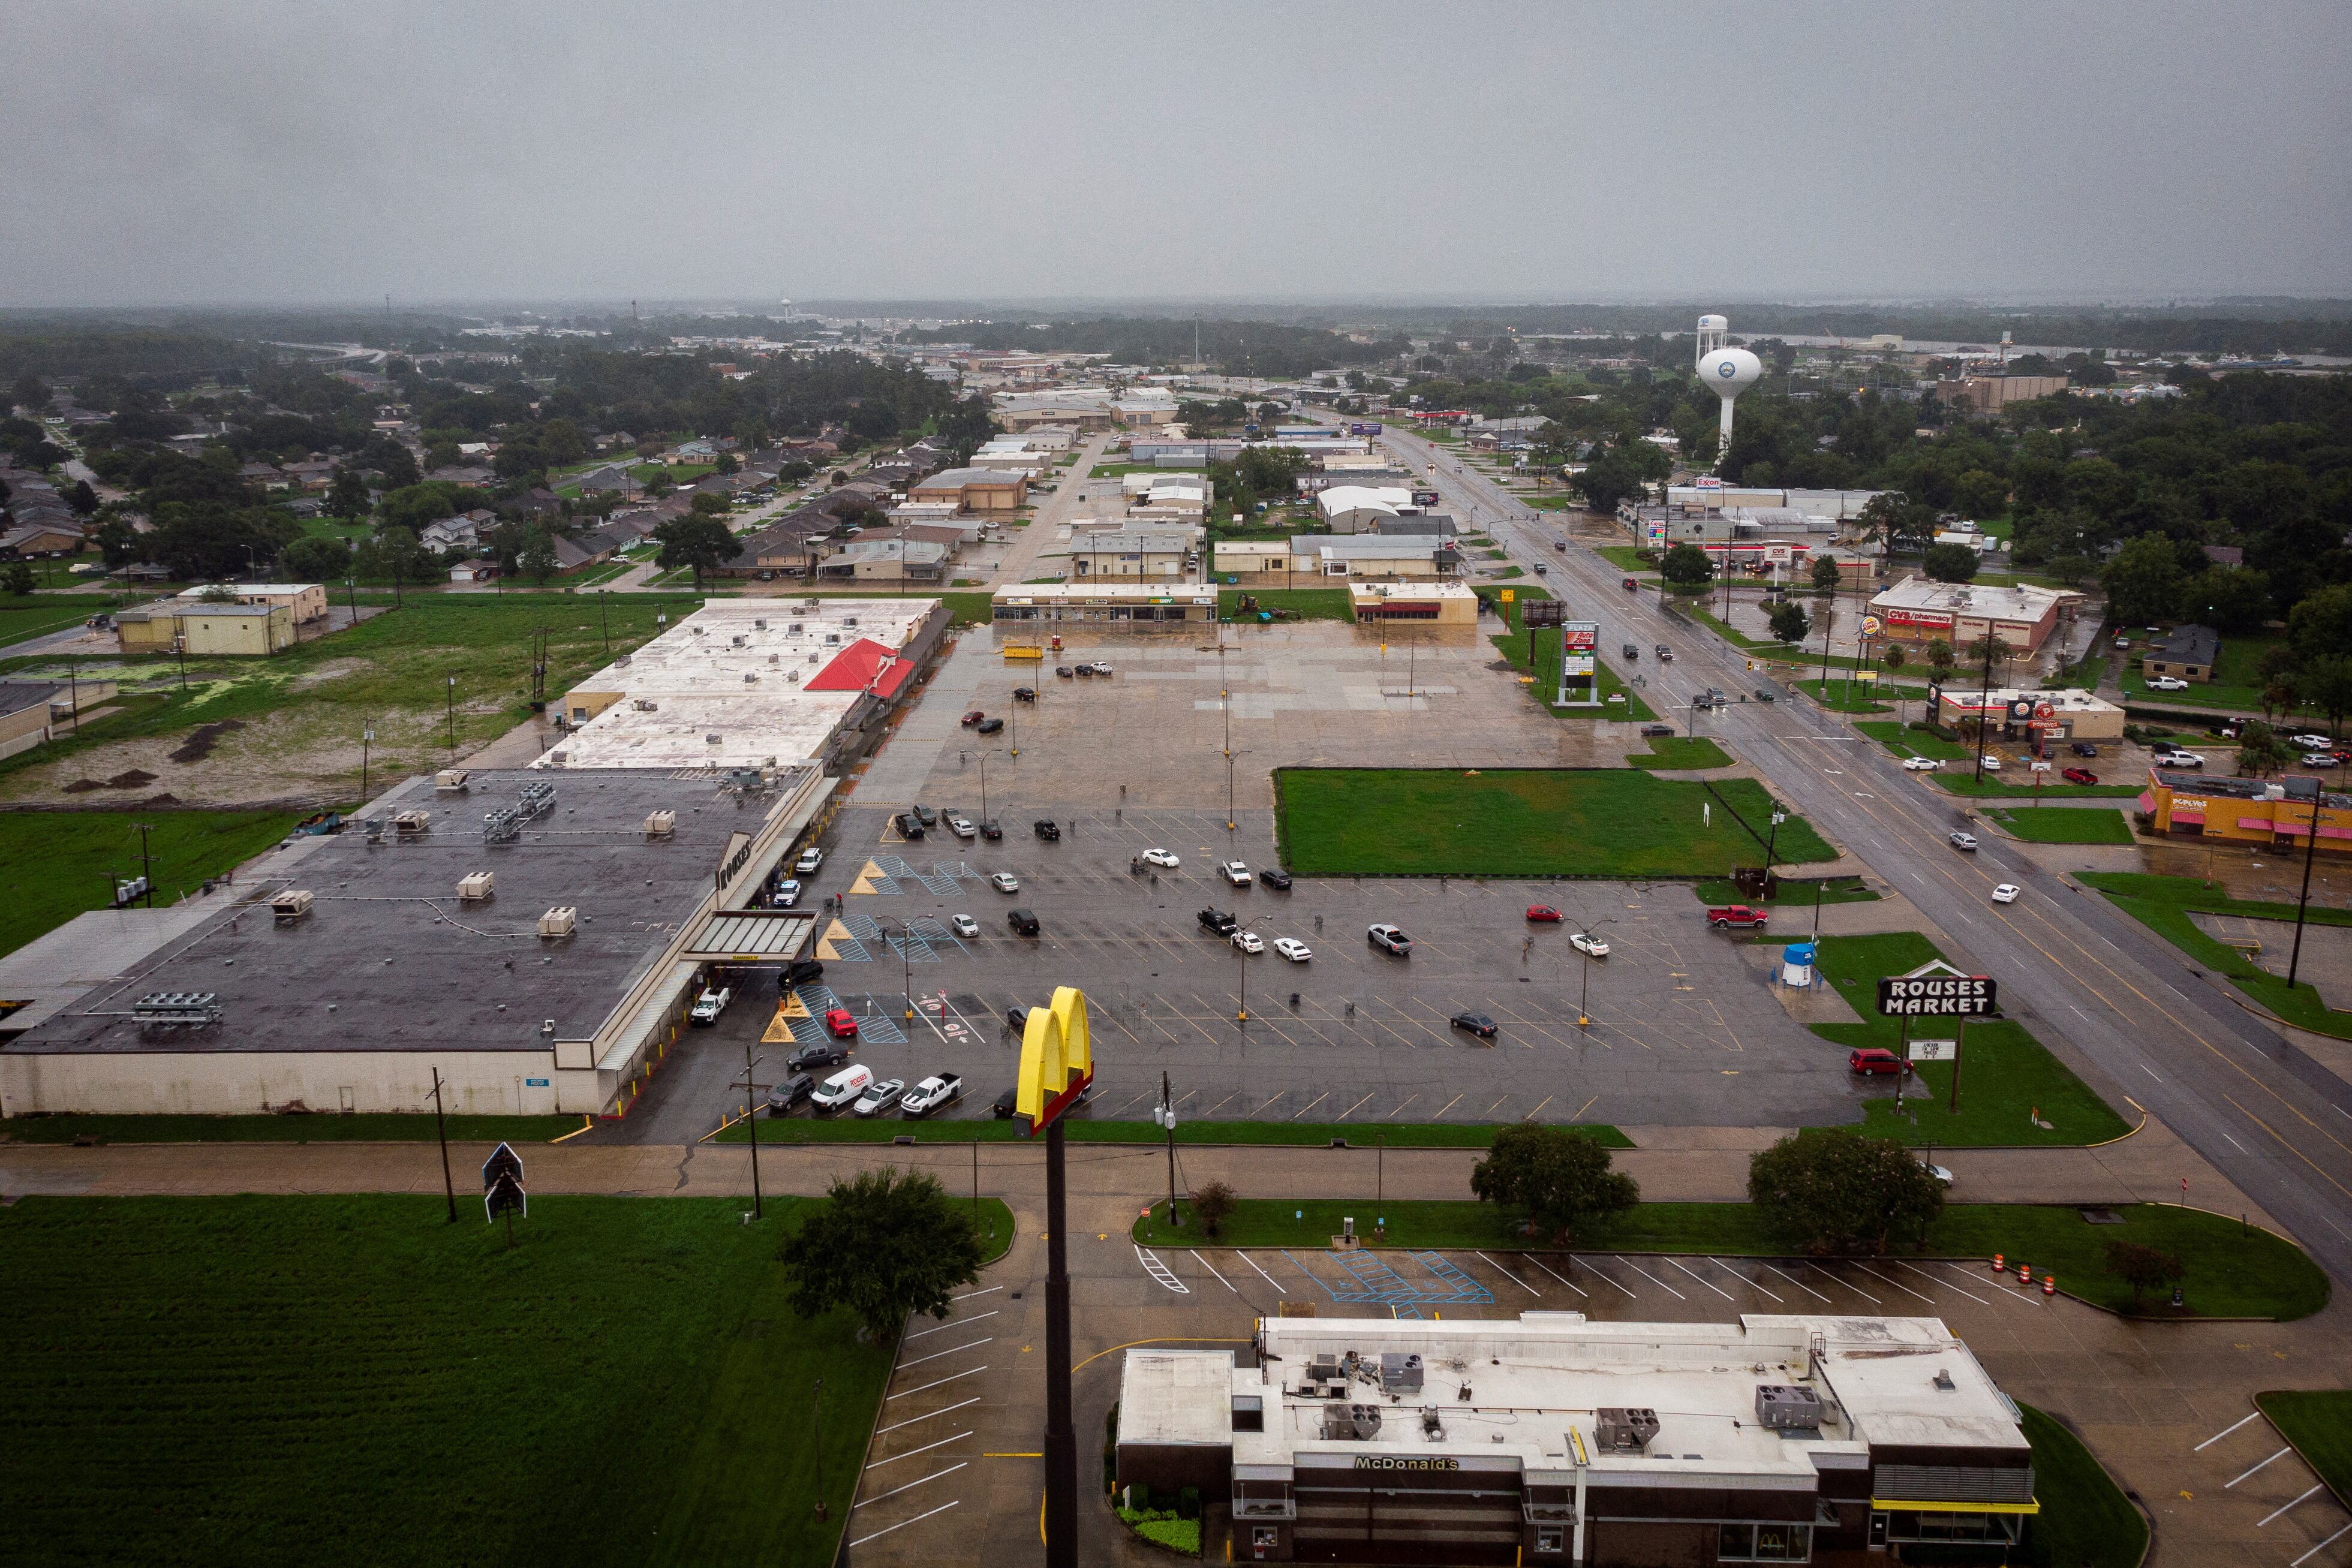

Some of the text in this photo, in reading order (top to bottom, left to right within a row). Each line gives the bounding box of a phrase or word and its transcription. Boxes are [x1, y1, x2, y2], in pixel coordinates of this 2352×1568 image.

[1863, 623, 1878, 631] KING
[720, 839, 751, 891] ROUSES
[1891, 981, 1984, 997] ROUSES
[1885, 998, 1988, 1014] MARKET
[850, 1073, 867, 1086] ROUSES
[1355, 1457, 1458, 1471] McDonald's
